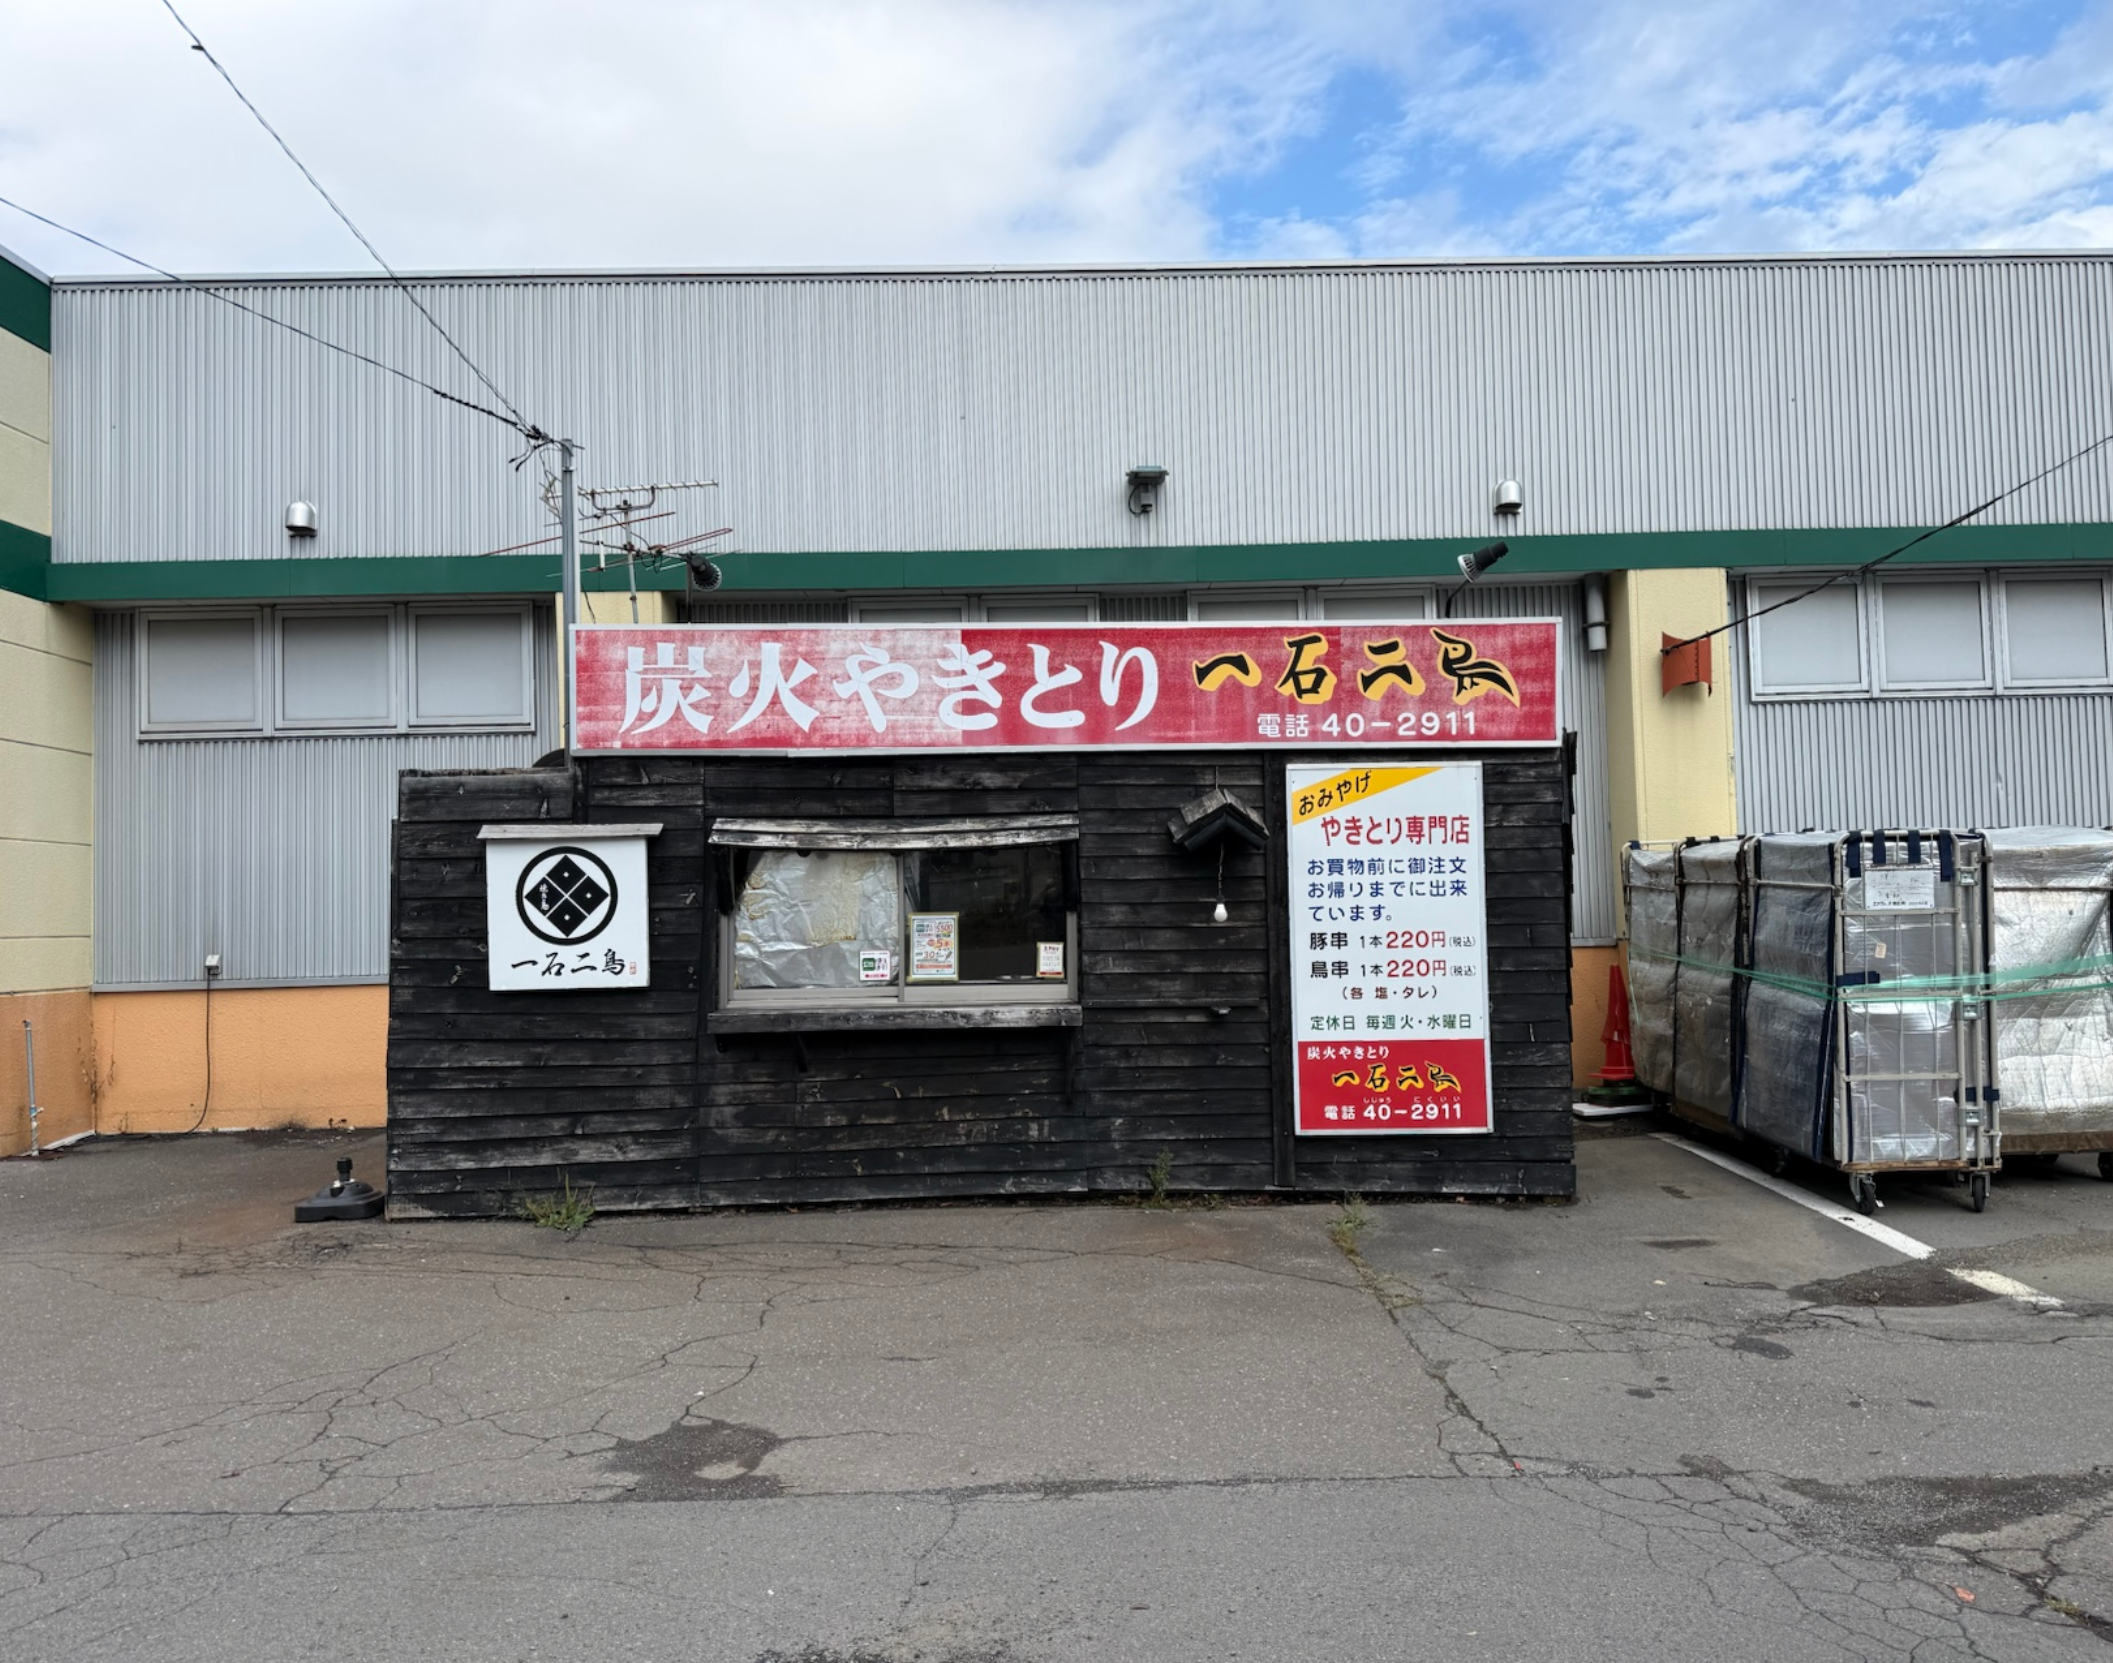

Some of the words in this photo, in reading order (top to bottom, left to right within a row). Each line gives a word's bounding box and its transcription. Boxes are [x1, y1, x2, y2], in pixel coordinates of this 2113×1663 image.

[619, 641, 1159, 734] 炭火やきとり
[1257, 713, 1309, 738] 電話
[1321, 710, 1476, 737] 40-2911
[1298, 770, 1372, 816] おみやげ
[1320, 815, 1470, 847] やきとり専門店
[1307, 856, 1467, 876] お買物前に御注文
[1307, 879, 1468, 899] お帰りまでに出来
[1308, 904, 1393, 922] ています。
[1309, 931, 1349, 950] 豚串
[511, 948, 626, 977] 一石二鳥
[1310, 960, 1349, 979] 鳥串
[1310, 1014, 1356, 1031] 定休日
[1306, 1045, 1391, 1061] 炭火やきとり
[1323, 1105, 1356, 1121] 電話
[1362, 1103, 1462, 1121] 40-2911
